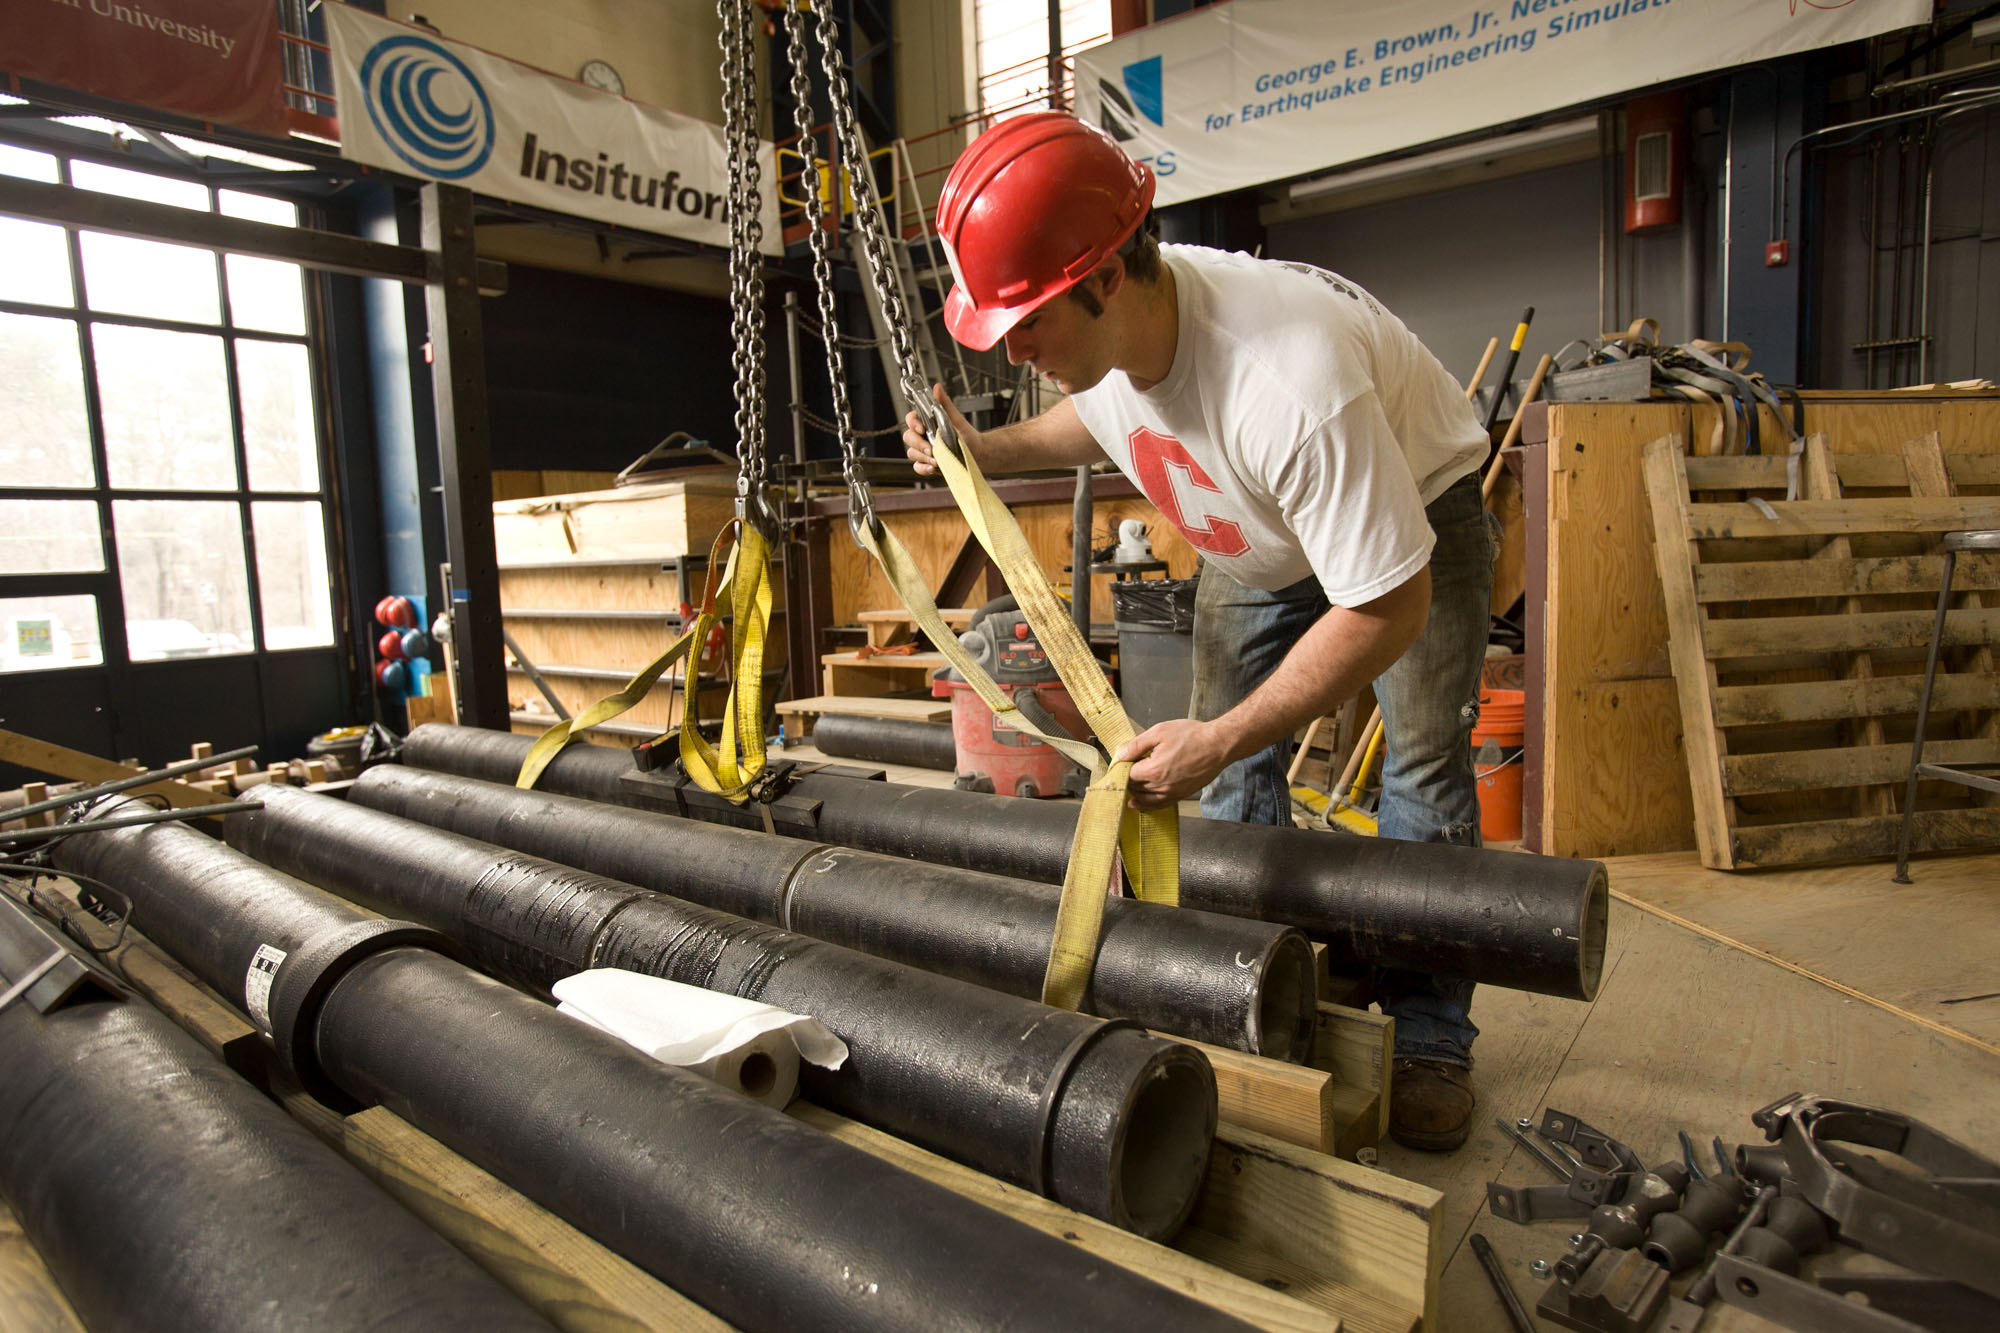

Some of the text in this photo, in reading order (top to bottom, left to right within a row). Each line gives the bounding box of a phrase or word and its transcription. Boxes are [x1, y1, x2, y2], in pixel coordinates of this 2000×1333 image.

[90, 0, 236, 58] University
[1204, 0, 1670, 132] for Earthquake Engineering Simula
[1255, 59, 1336, 93] George
[1344, 48, 1364, 69] E.
[1374, 24, 1460, 61] Brown,
[1467, 11, 1499, 38] Jr.
[520, 132, 731, 223] Insitufor
